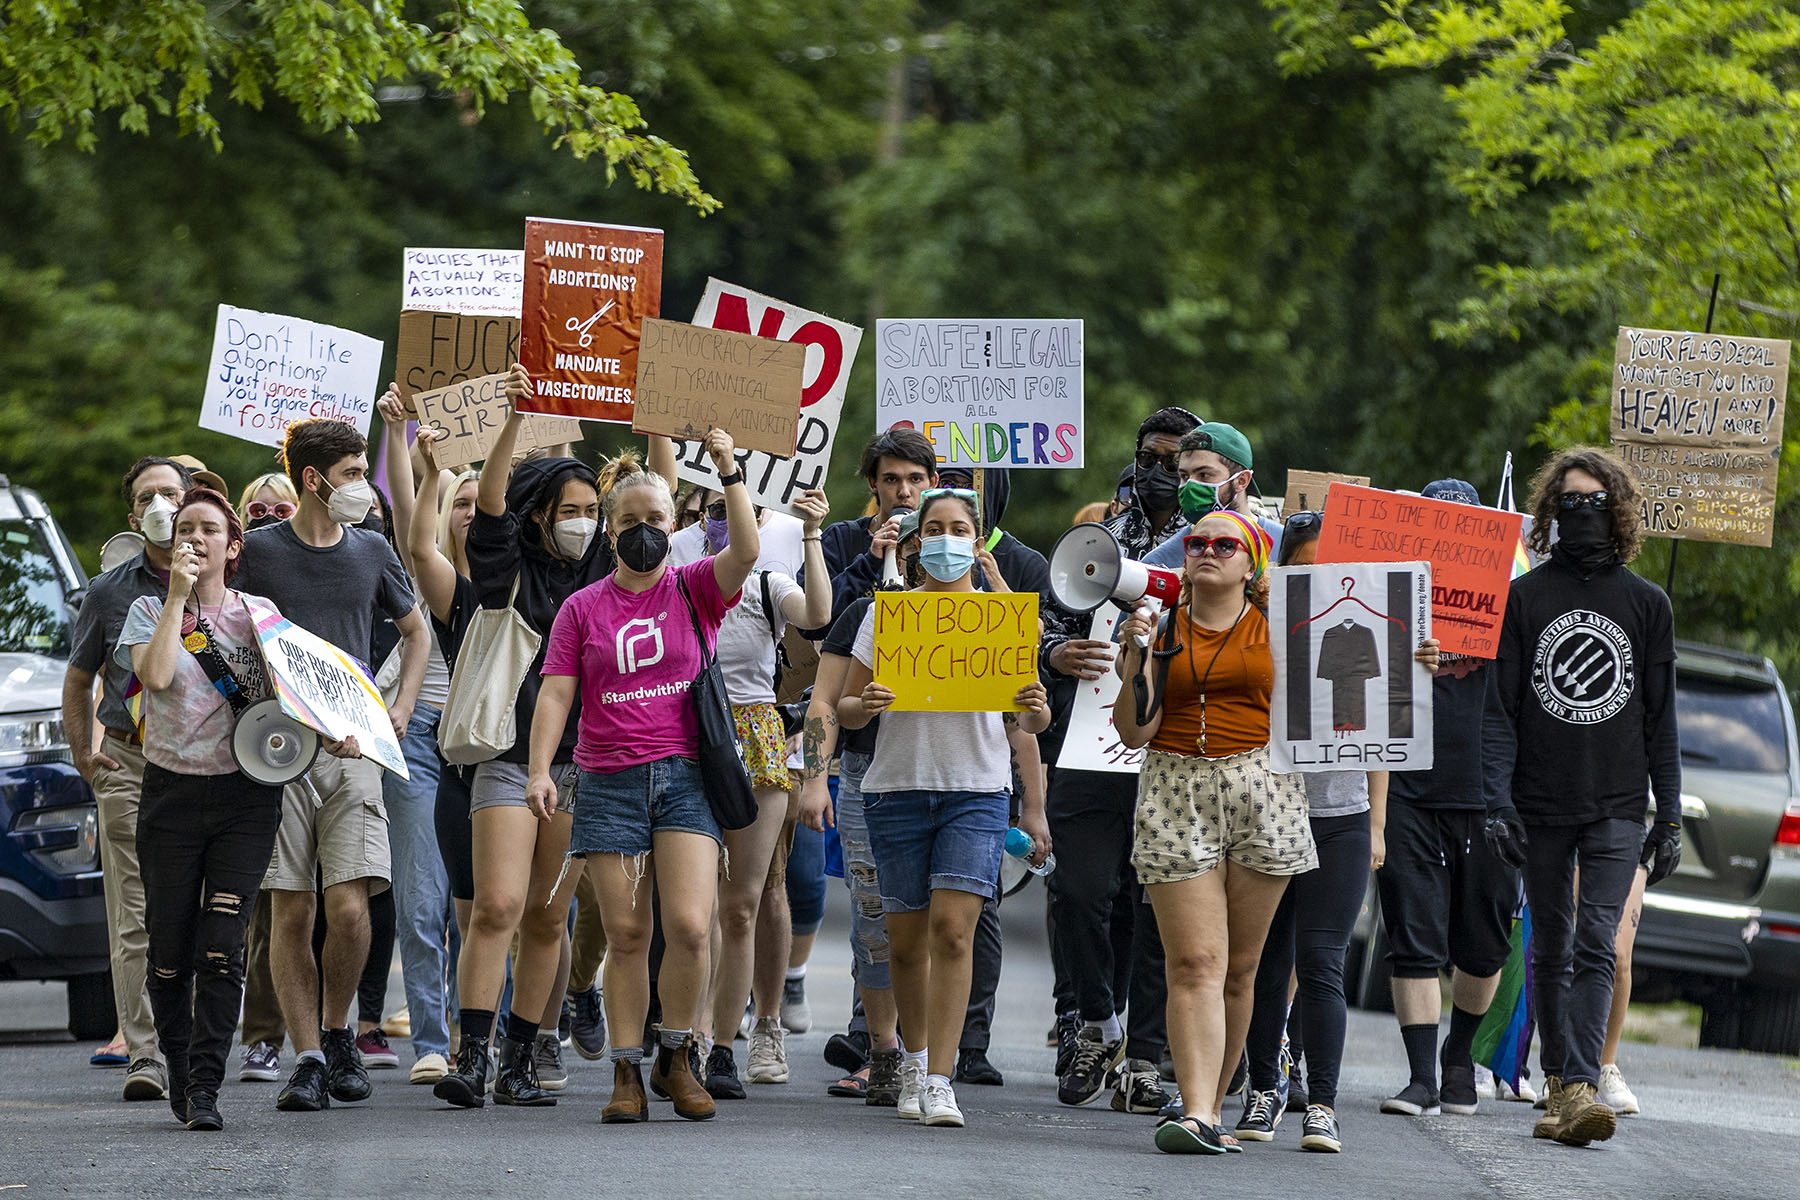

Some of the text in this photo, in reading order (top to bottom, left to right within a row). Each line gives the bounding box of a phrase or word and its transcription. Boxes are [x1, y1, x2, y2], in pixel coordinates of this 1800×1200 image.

[407, 250, 520, 267] POLICIES THAT
[545, 240, 645, 265] WANT TO STOP
[408, 270, 484, 285] ACTUALLY
[548, 269, 638, 292] ABORTIONS?
[228, 318, 353, 364] Don't like
[430, 314, 520, 376] FUCK
[644, 320, 758, 367] DEMOCRACY
[882, 322, 979, 369] SAFE
[995, 325, 1081, 368] LEGAL
[1626, 330, 1776, 368] YOUR FLAG DECAL
[219, 364, 260, 389] Just
[263, 377, 308, 398] ignore
[224, 349, 327, 383] abortions?
[555, 353, 621, 375] MANDATE
[640, 360, 775, 402] A TYRANNICAL
[1618, 362, 1775, 393] WON'T GET YOU INTO
[218, 400, 233, 418] in
[226, 384, 257, 401] you
[309, 400, 357, 426] Children
[536, 380, 635, 405] VASECTOMIES.
[880, 375, 1068, 407] ABORTION FOR
[636, 388, 719, 423] RELIGIOUS
[727, 407, 798, 441] MINORITY
[965, 404, 998, 417] ALL
[1618, 387, 1763, 436] HEAVEN ANY
[437, 419, 577, 465] ENSVEMENT
[889, 420, 1078, 465] ENDERS
[1619, 442, 1679, 466] THEY'RE
[1681, 449, 1730, 470] ALREADY
[1725, 471, 1764, 491] DIRTY
[1369, 499, 1388, 521] IS
[1396, 503, 1428, 527] TIME
[1433, 509, 1450, 530] TO
[1455, 513, 1508, 542] RETURN
[1336, 524, 1503, 572] THE ISSUE OF ABORTION
[879, 597, 1029, 638] MY BODY,
[1432, 586, 1500, 616] IVIDUAL
[235, 646, 261, 660] TRAN
[1534, 612, 1633, 667] SOMETIMES ANTISOCIAL
[228, 653, 260, 668] RIGHT
[278, 637, 364, 698] OUR RIGHTS
[876, 644, 1035, 680] MY CHOICE!
[287, 658, 368, 711] ARE NOT UP
[1535, 682, 1632, 722] ALWAYS ANTIFASCIST
[292, 674, 376, 736] FOR DEBATE
[1293, 742, 1409, 765] LIARS
